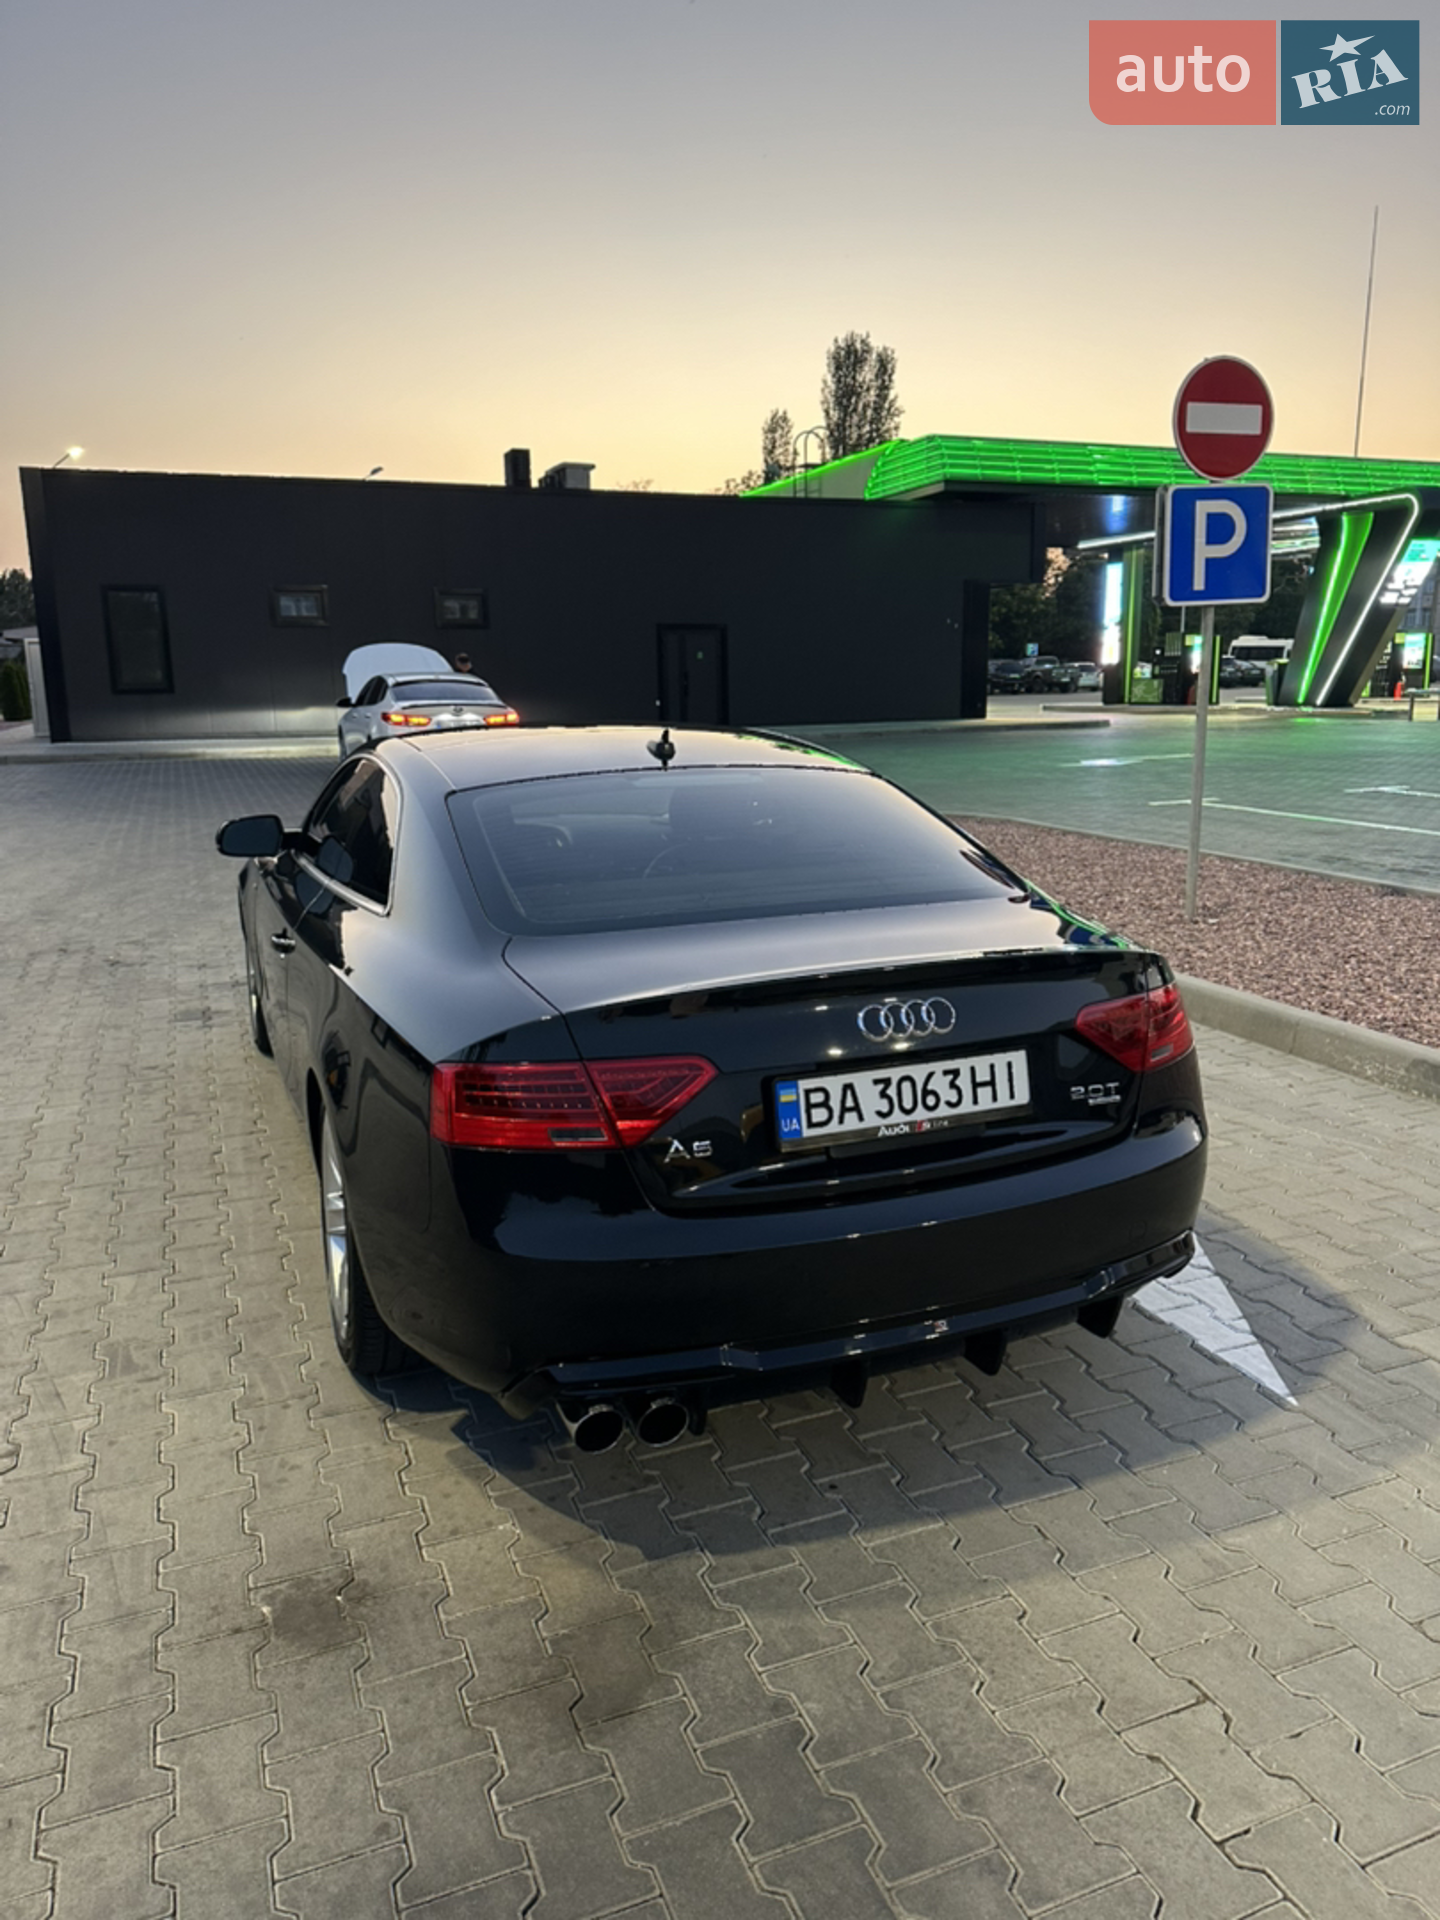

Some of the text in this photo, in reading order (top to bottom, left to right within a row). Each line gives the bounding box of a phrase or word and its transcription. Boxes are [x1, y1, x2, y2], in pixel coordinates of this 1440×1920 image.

[1192, 499, 1248, 592] P
[781, 1118, 800, 1132] UA
[664, 1139, 713, 1163] A5
